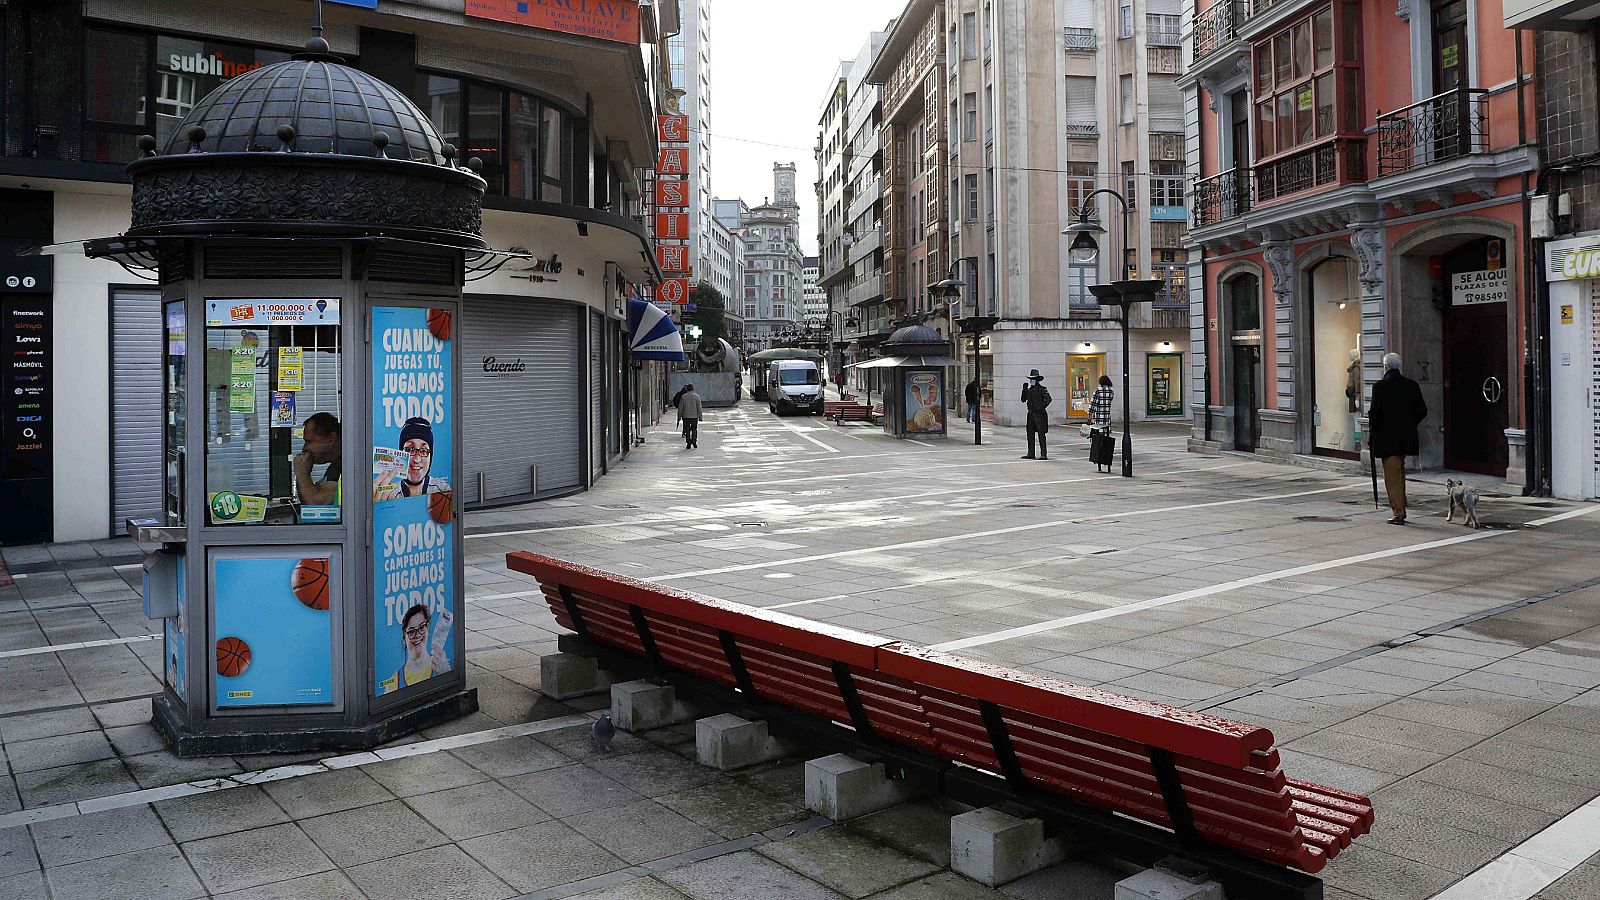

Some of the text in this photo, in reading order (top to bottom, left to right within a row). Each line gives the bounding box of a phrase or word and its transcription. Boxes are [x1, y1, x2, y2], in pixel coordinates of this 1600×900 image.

[661, 116, 684, 302] CASINO
[1454, 282, 1486, 291] PLAZAS
[1461, 274, 1472, 283] SE
[382, 328, 445, 354] CUANDO
[384, 355, 423, 371] JUEGAS
[483, 356, 526, 372] Cuende
[382, 371, 445, 395] JUGAMOS
[382, 395, 445, 428] TODOS
[213, 494, 239, 516] +18
[383, 519, 445, 558] SOMOS
[384, 547, 445, 572] CAMPEONES SI
[384, 562, 445, 595] JUGAMOS
[384, 584, 445, 627] TODOS
